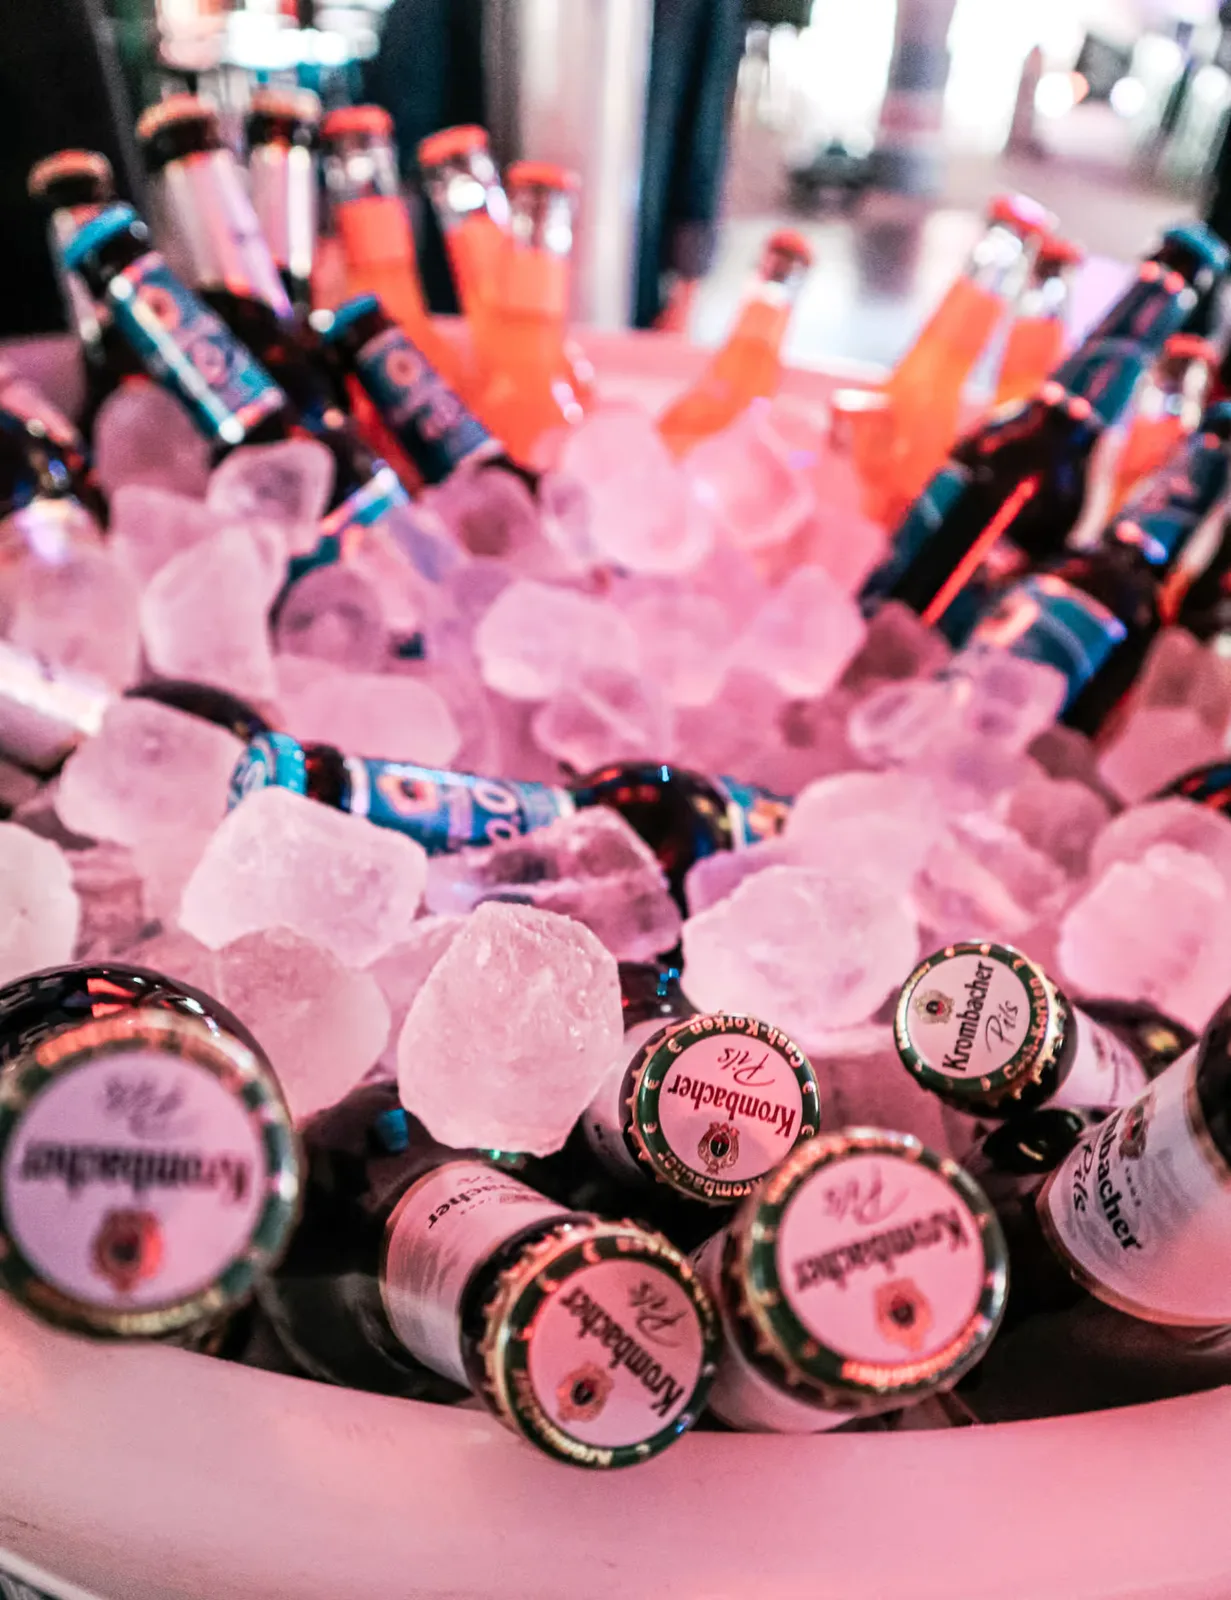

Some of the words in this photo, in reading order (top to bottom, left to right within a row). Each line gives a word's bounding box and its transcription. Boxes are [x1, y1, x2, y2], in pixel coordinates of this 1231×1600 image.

[689, 1015, 805, 1068] Cash-Korken
[942, 960, 995, 1072] Krombacher
[985, 999, 1019, 1053] Pils
[717, 1047, 776, 1087] Pils
[667, 1074, 796, 1139] Krombacher
[1073, 1140, 1094, 1213] Pils
[794, 1207, 970, 1294] Krombacher
[628, 1281, 688, 1348] Pils
[559, 1286, 684, 1418] Krombacher
